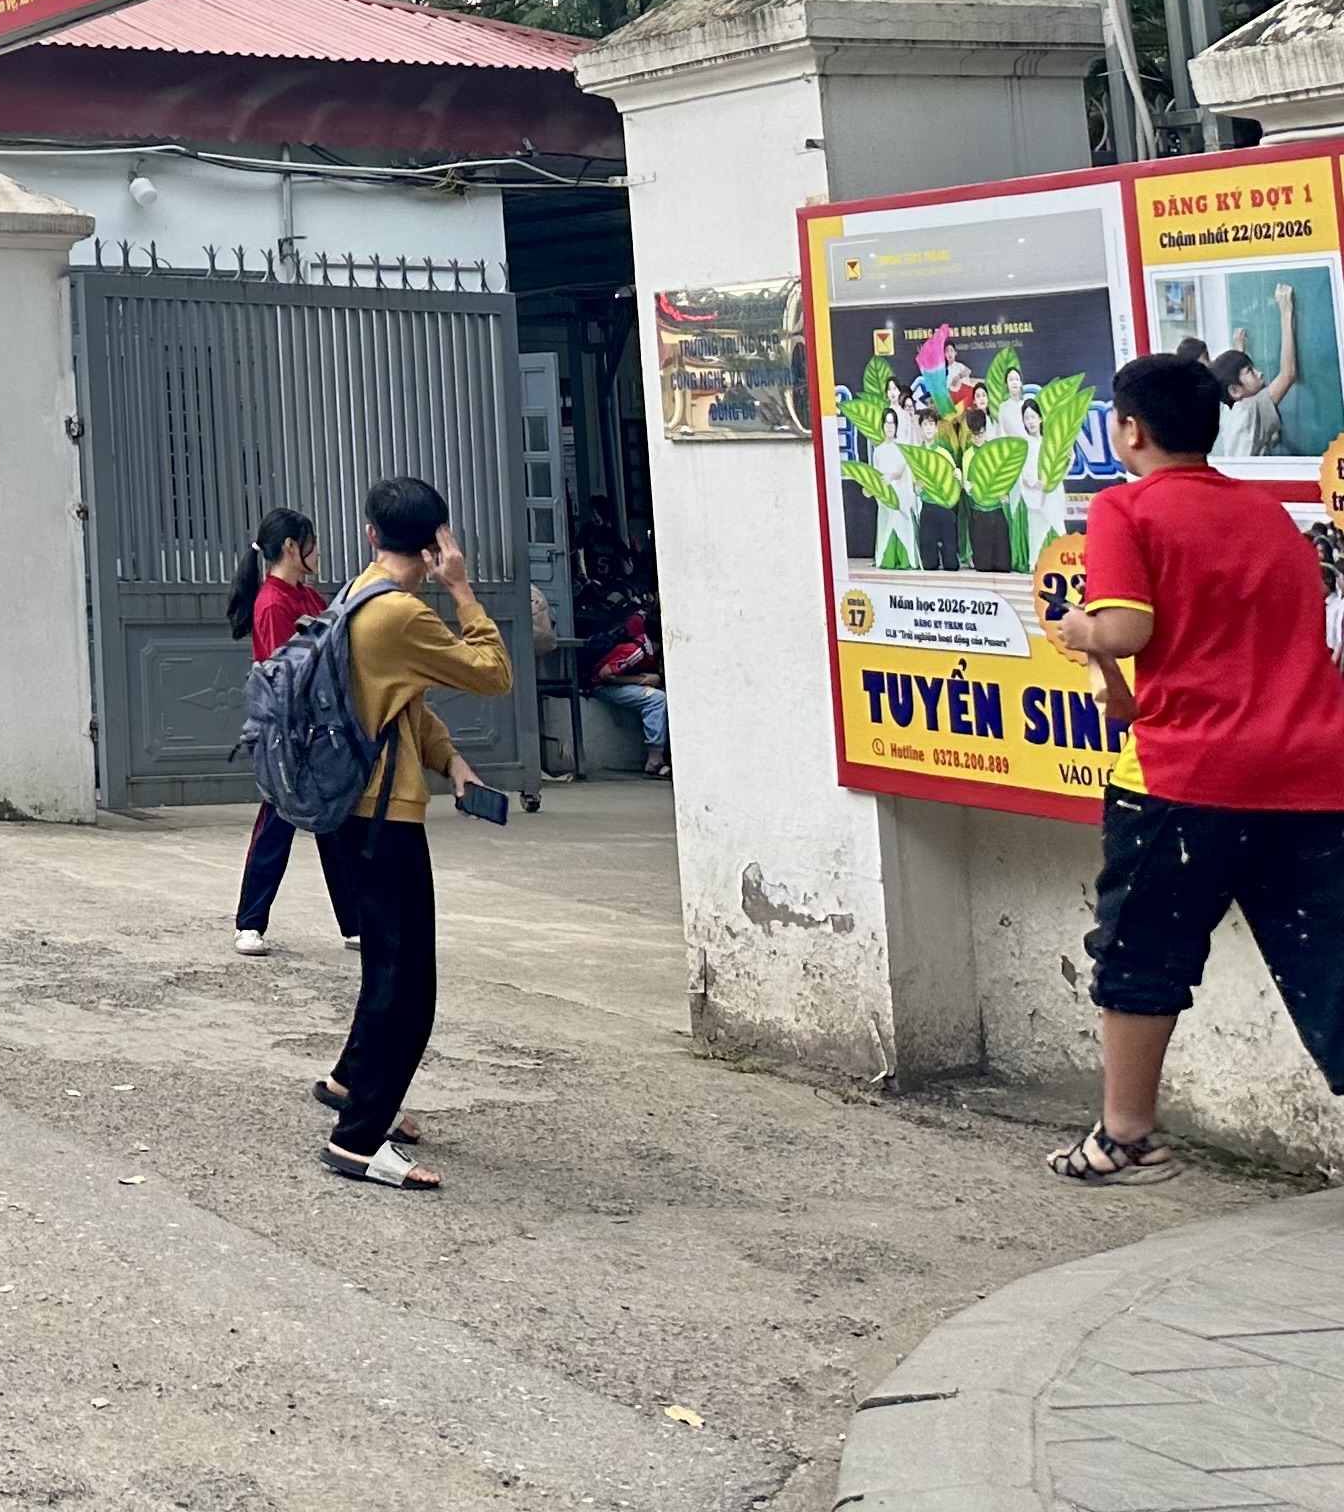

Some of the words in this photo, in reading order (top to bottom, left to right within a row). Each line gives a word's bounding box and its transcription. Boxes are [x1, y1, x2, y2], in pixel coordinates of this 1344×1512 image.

[1152, 194, 1208, 217] ĐĂNG
[1216, 186, 1243, 211] KÝ
[1250, 185, 1294, 210] ĐỢT
[1303, 183, 1313, 203] 1
[1159, 230, 1196, 251] Chậm
[1199, 222, 1229, 246] nhất
[1232, 219, 1313, 243] 22/02/2026
[848, 609, 866, 627] 17
[889, 594, 914, 610] Năm
[915, 597, 935, 614] học
[937, 598, 999, 616] 2026-2027
[862, 658, 1004, 740] TUYỂN
[890, 743, 925, 762] Hotline
[933, 748, 1010, 774] 0378.200.889
[1058, 759, 1093, 786] VÀO
